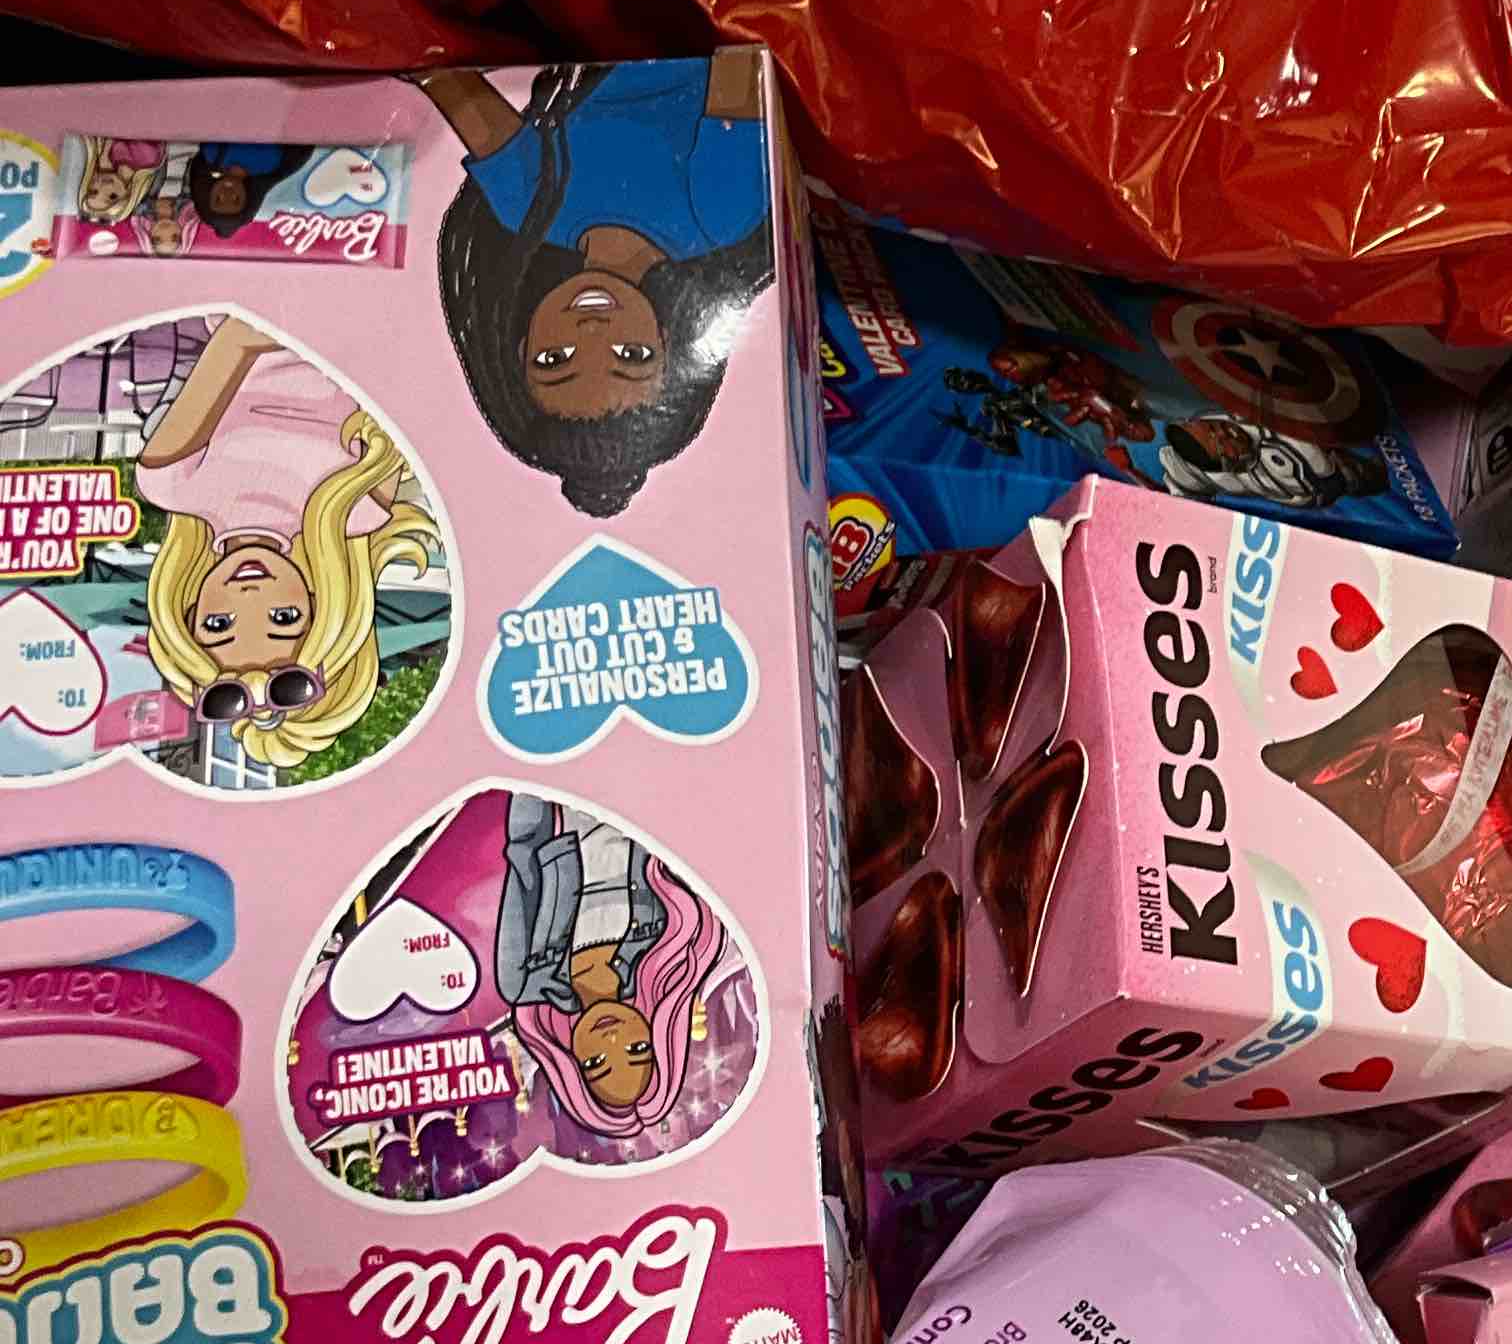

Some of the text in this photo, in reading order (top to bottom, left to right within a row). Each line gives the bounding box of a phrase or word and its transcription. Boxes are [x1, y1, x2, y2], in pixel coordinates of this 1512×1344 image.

[268, 208, 389, 262] Barbie
[11, 504, 133, 537] ONE OF A
[1206, 555, 1220, 595] brand
[501, 590, 719, 649] HEART CARDS
[18, 638, 77, 661] FROM:
[536, 626, 696, 678] & CUT OUT
[57, 687, 88, 708] TO:
[511, 656, 728, 717] PERSONALIZE
[1140, 864, 1166, 957] HERSHEY'S
[402, 932, 452, 955] FROM:
[440, 971, 467, 990] TO:
[336, 1035, 487, 1085] VALENTINE!
[314, 1063, 512, 1120] YOU'RE ICONIC,
[1073, 1297, 1117, 1338] 2026
